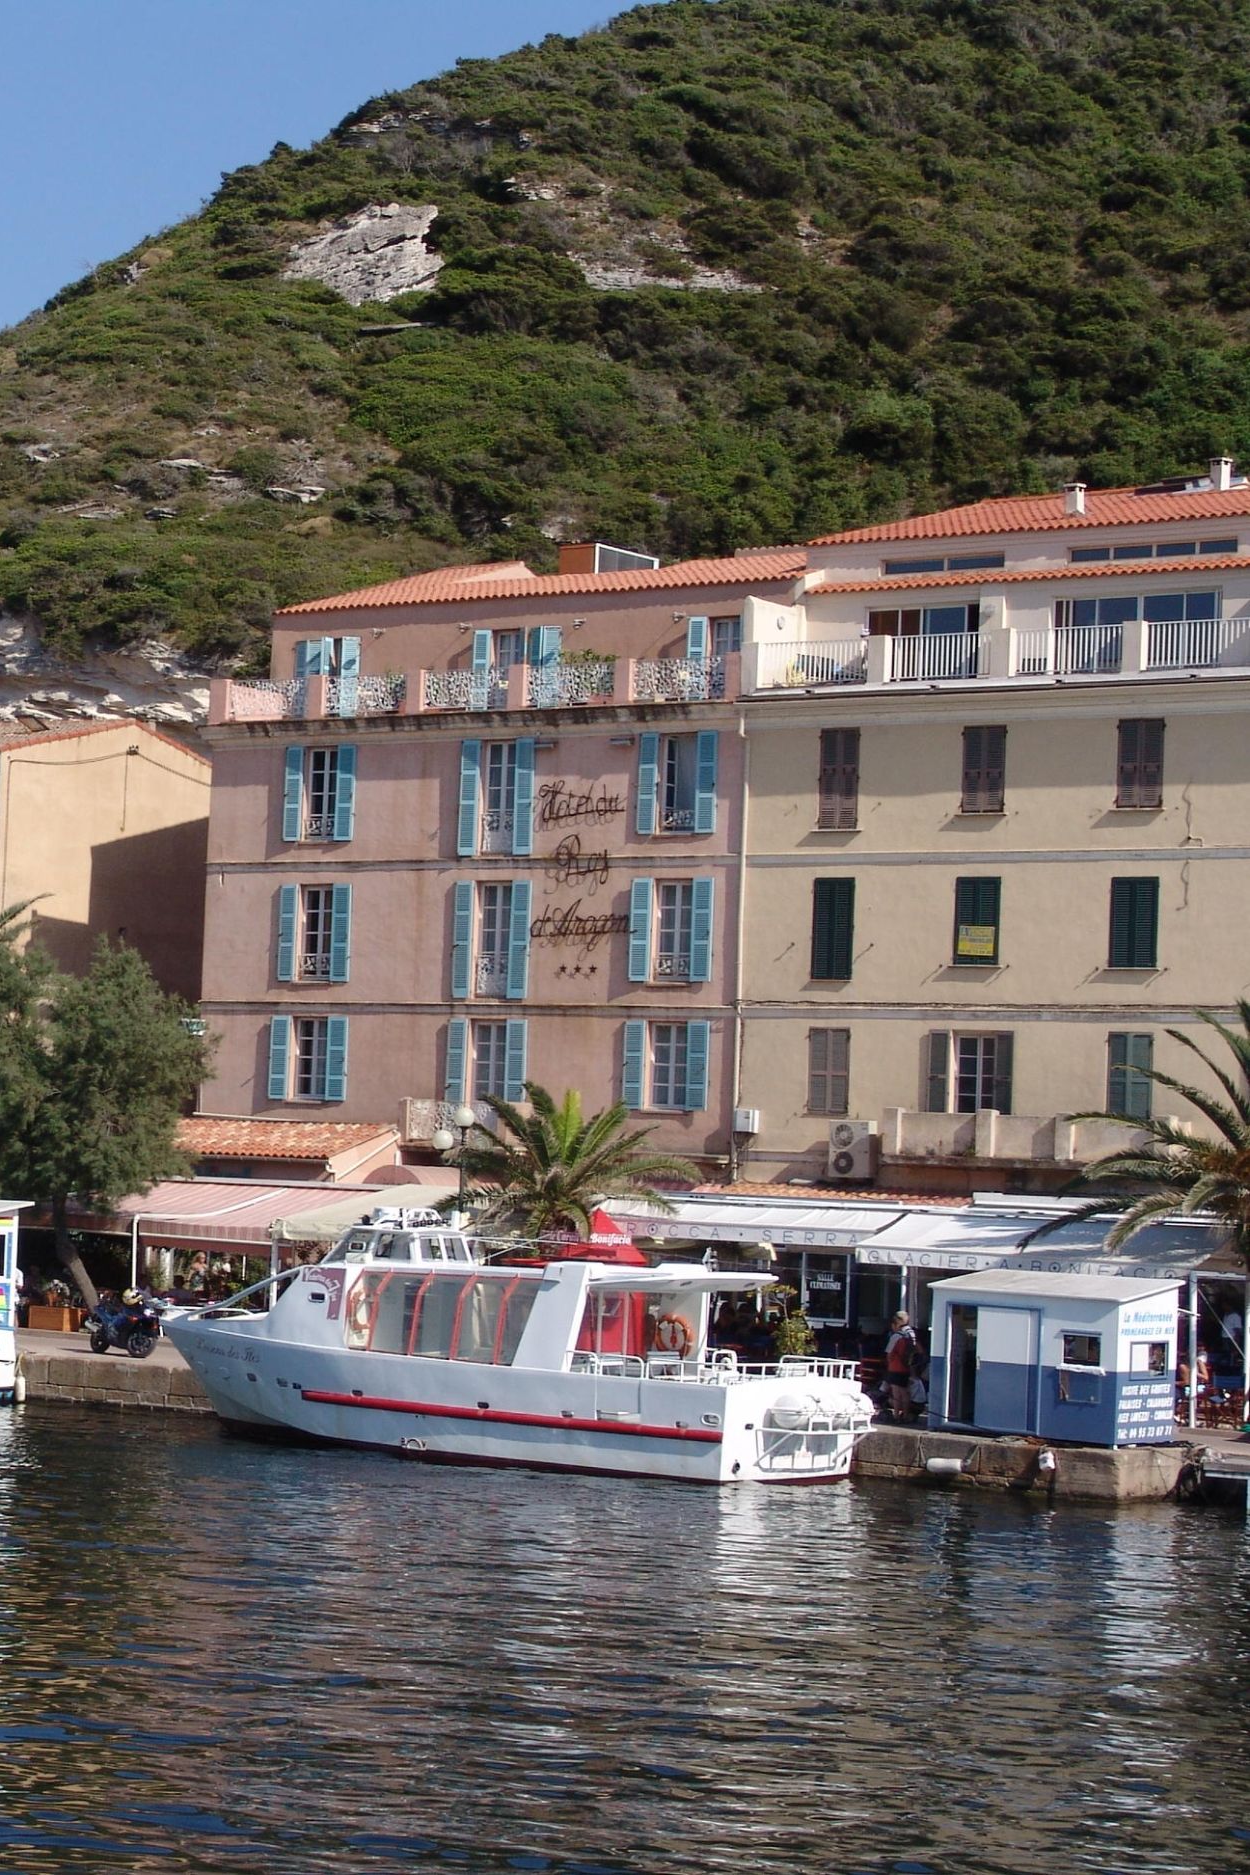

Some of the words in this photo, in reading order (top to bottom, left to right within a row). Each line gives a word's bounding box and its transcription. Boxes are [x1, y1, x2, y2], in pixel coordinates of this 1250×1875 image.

[596, 784, 625, 816] du
[556, 834, 609, 884] Roy
[590, 1233, 631, 1246] Bonifacio
[626, 1222, 720, 1239] ROCCA
[762, 1230, 858, 1245] SERRA
[868, 1251, 977, 1268] GLACIER
[1031, 1260, 1177, 1279] BONIFACIO
